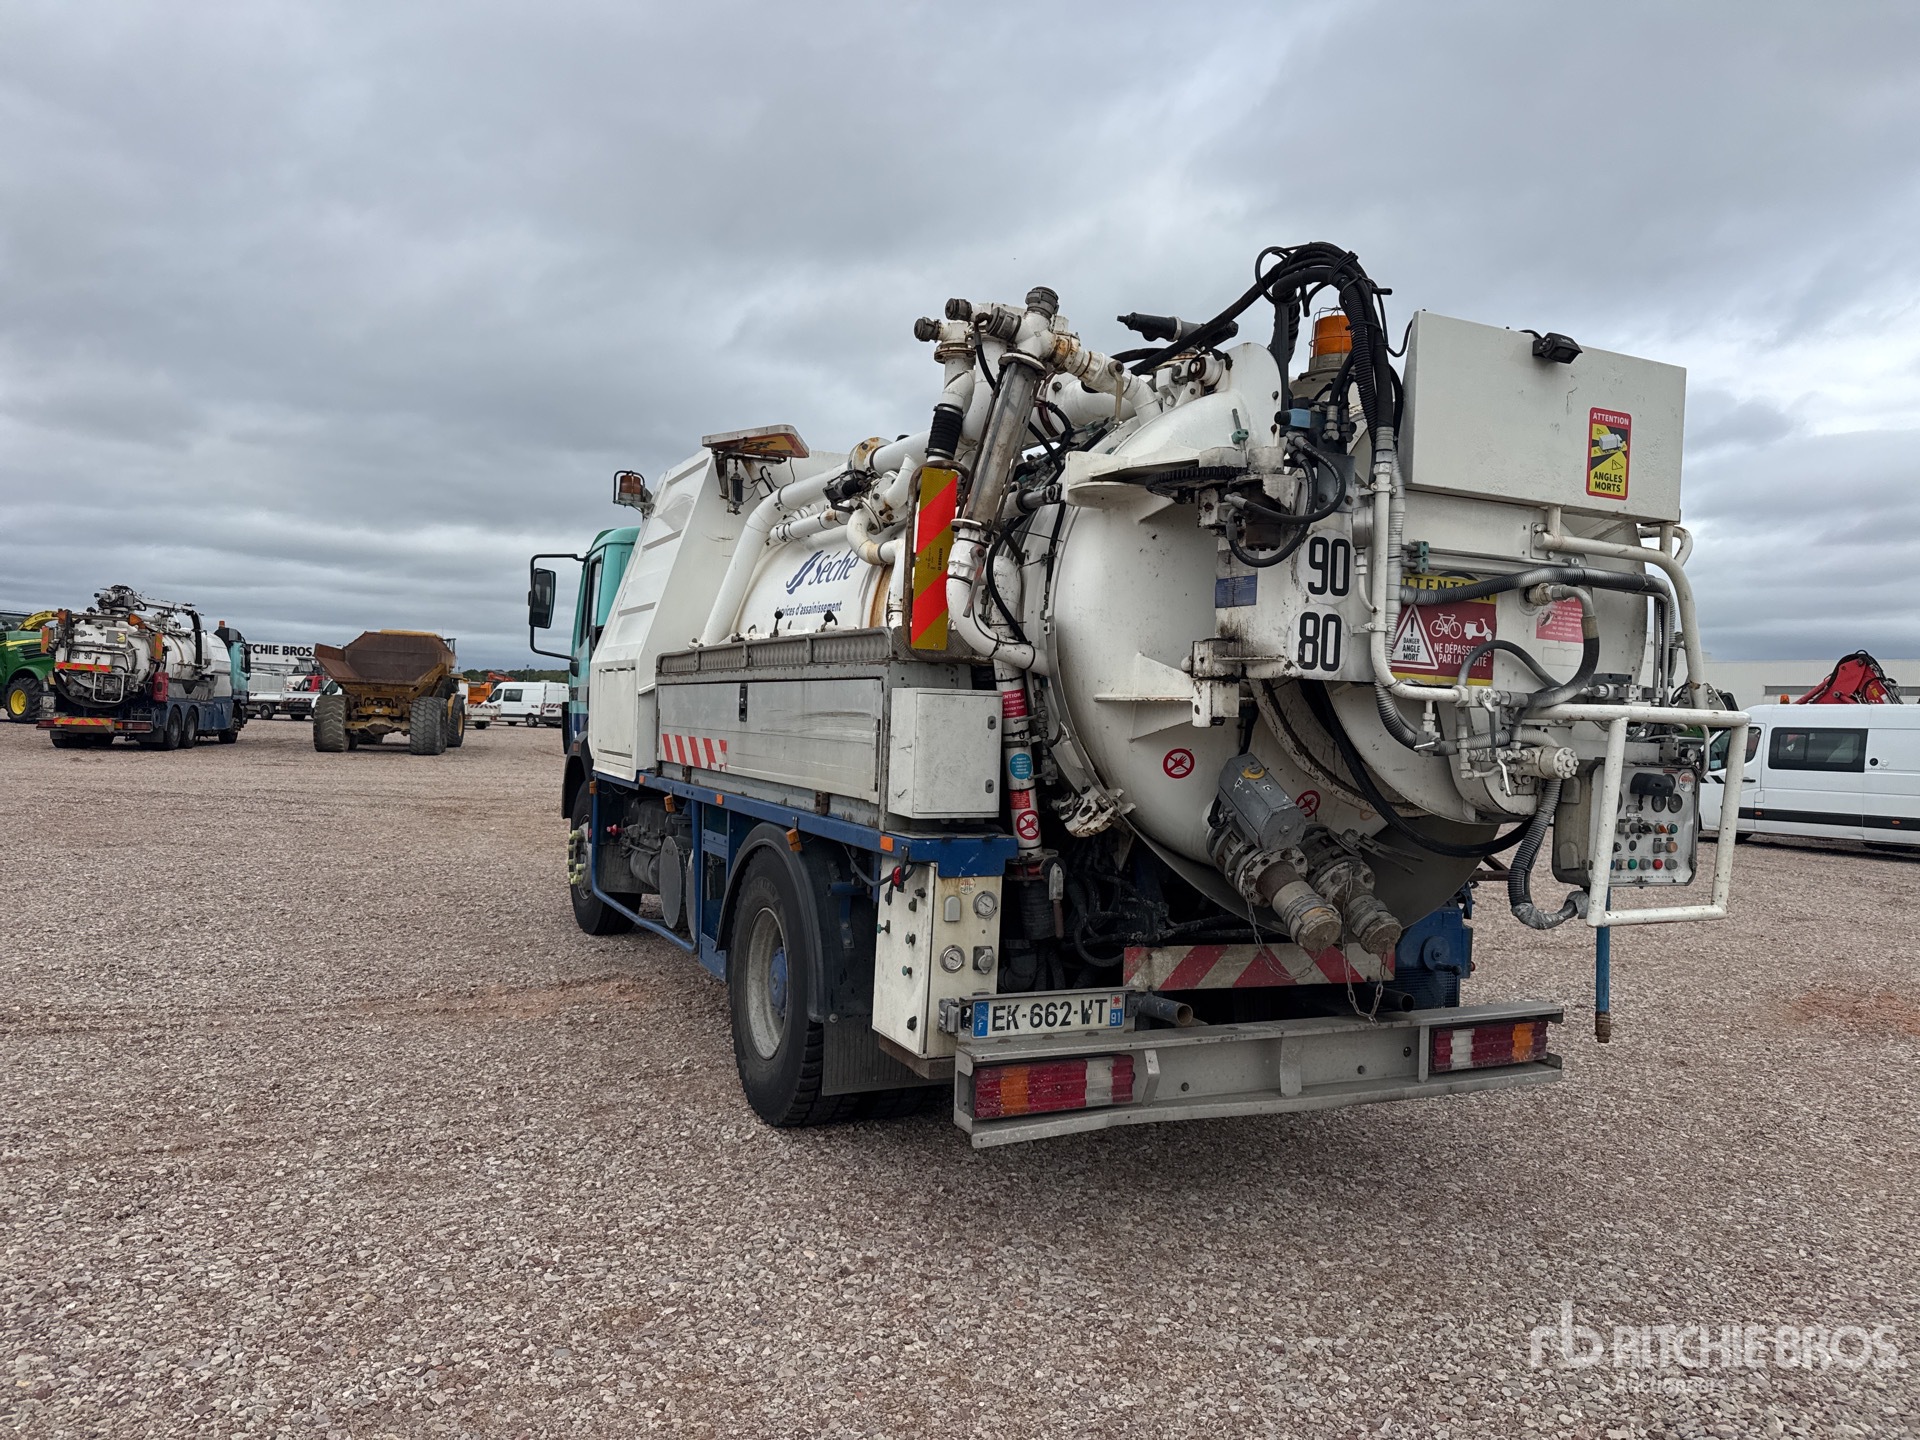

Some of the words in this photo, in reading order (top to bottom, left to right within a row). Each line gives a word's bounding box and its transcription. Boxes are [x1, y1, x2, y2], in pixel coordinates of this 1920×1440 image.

[1592, 412, 1630, 426] ATTENTION
[1593, 471, 1623, 484] ANGLES
[1594, 481, 1621, 493] MORTS
[1307, 536, 1350, 597] 90
[1297, 611, 1342, 672] 80
[246, 643, 279, 655] TCHIE
[1402, 644, 1420, 653] ANGLE
[1434, 643, 1444, 653] NE
[1444, 642, 1477, 655] DÉPASSE
[1403, 653, 1419, 662] MORT
[1438, 653, 1452, 664] PAR
[1453, 655, 1462, 665] LA
[992, 999, 1108, 1032] EK-662-WT
[1111, 1011, 1121, 1024] 91
[978, 1022, 984, 1031] F
